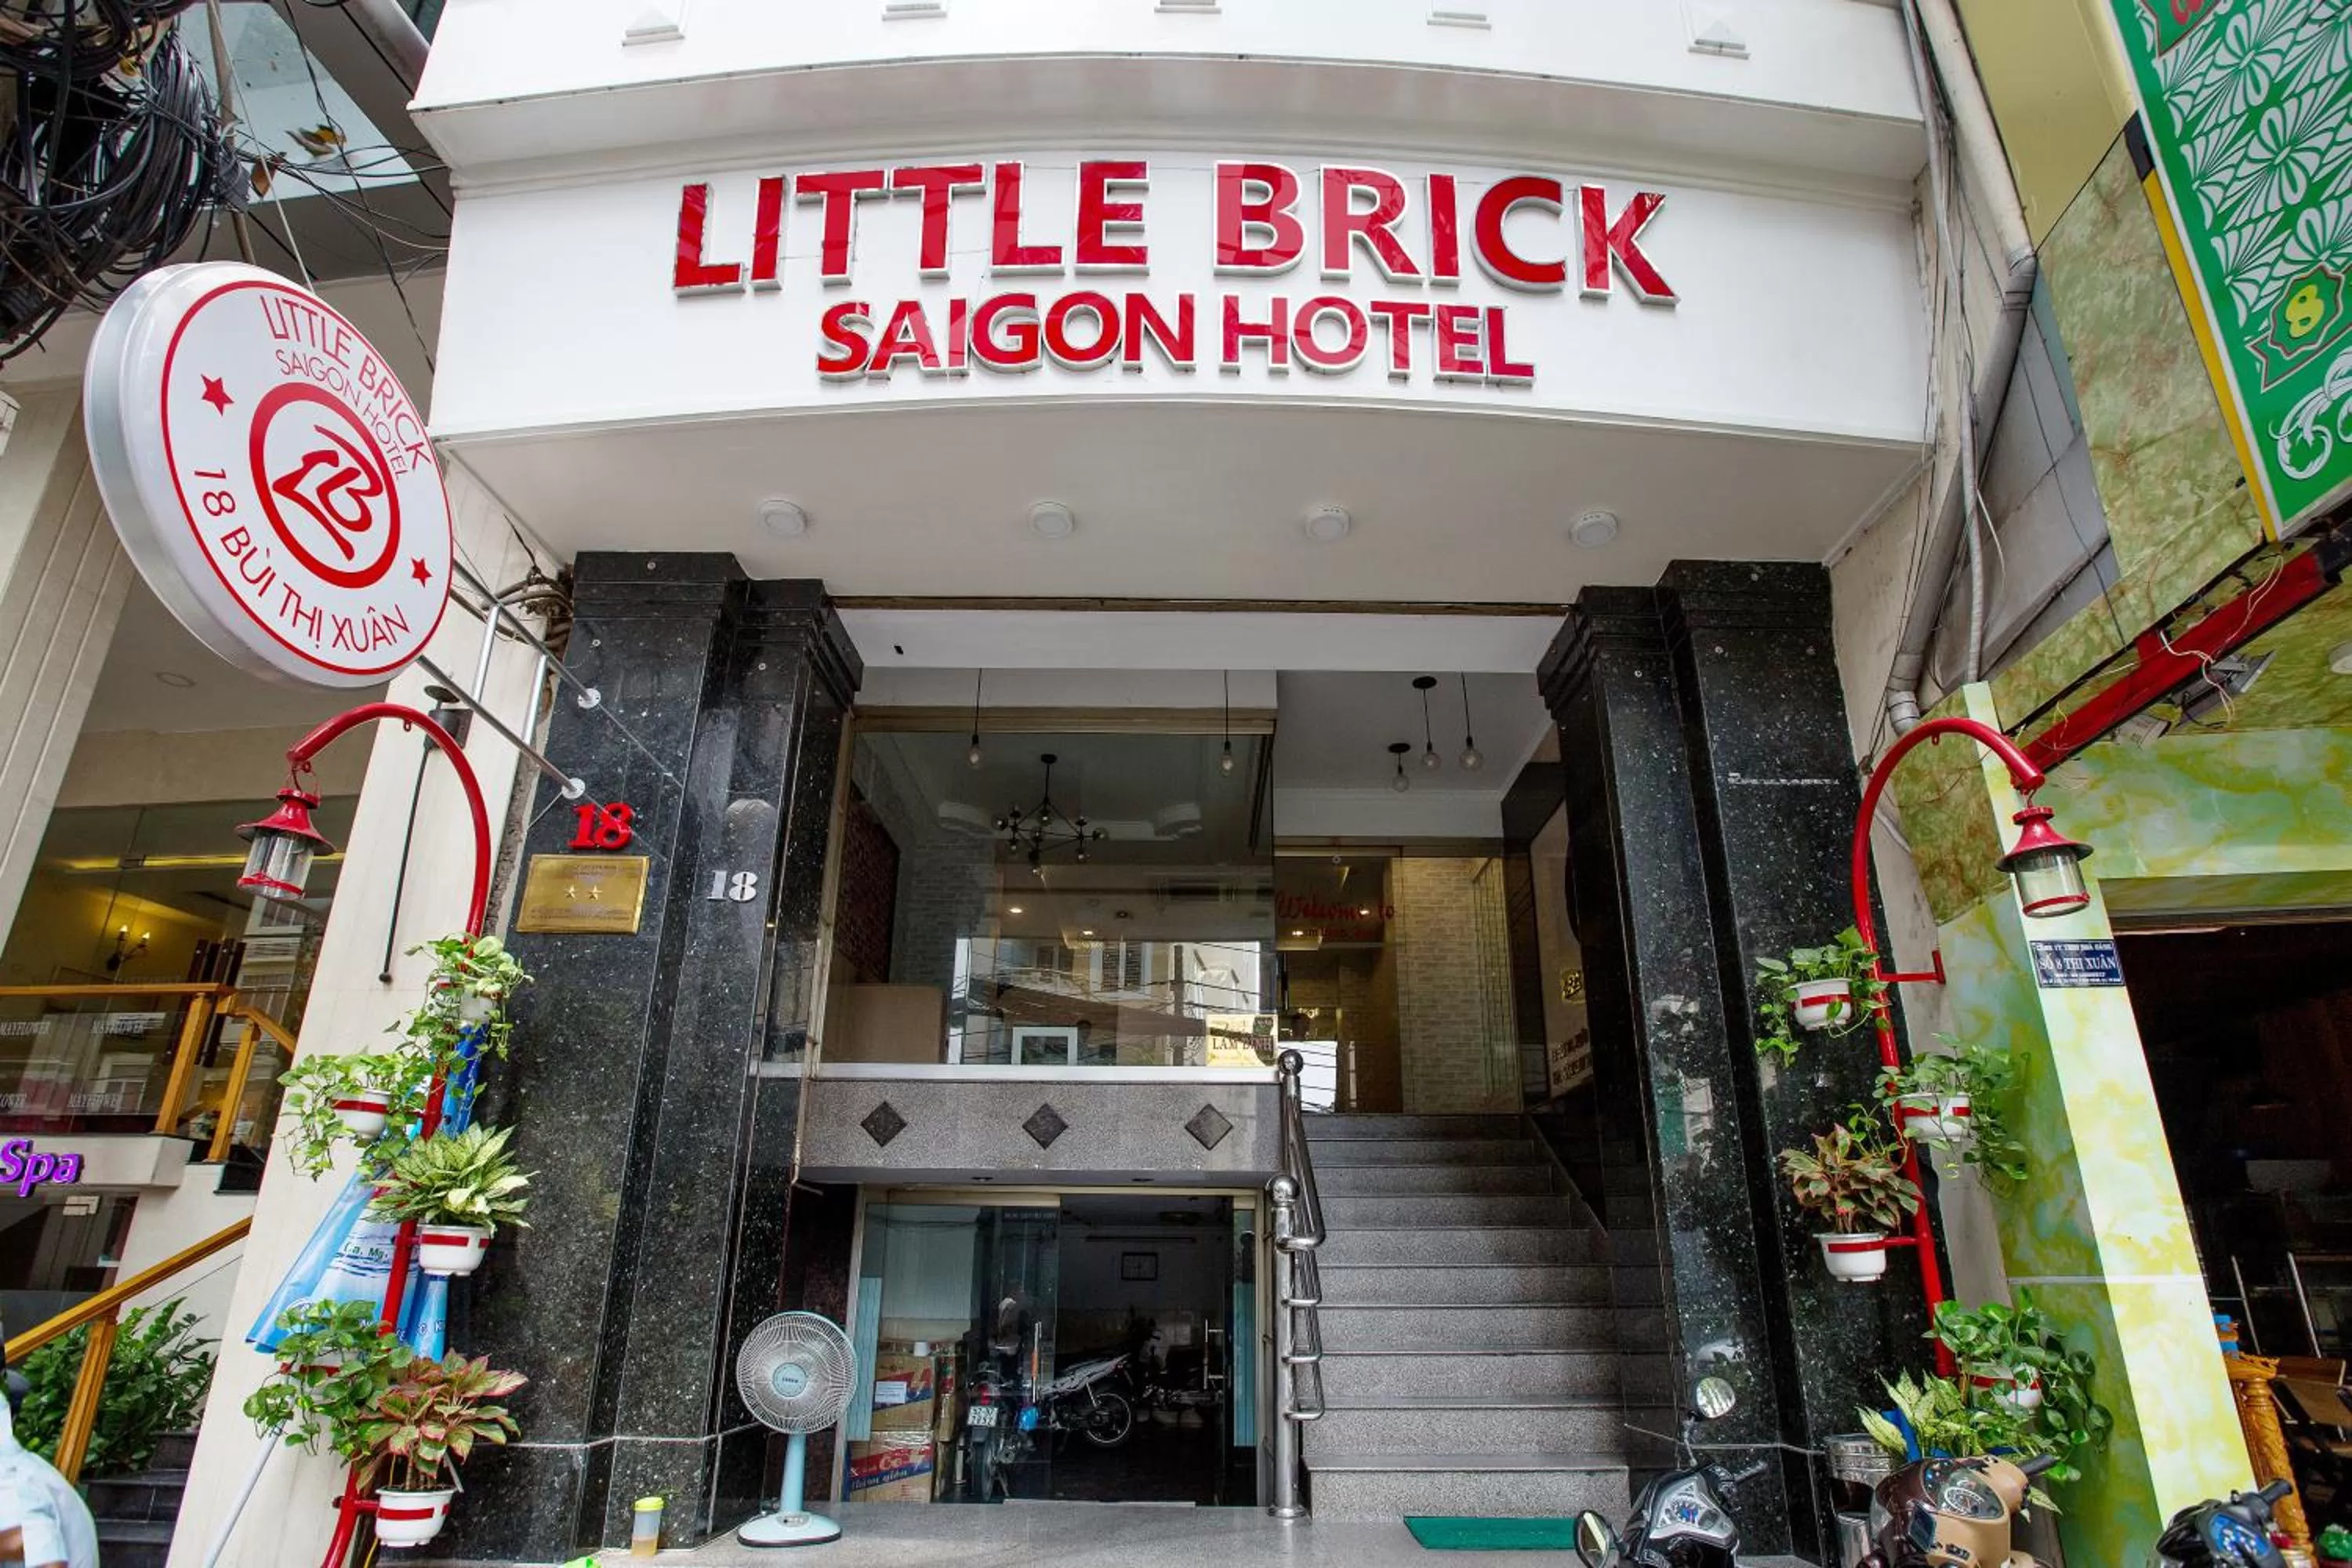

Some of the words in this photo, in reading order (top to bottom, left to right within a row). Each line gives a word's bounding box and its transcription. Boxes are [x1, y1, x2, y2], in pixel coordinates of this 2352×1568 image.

[673, 161, 1149, 296] LITTLE
[1213, 161, 1679, 309] BRICK
[260, 295, 352, 370] LITTLE
[358, 354, 431, 470] BRICK
[815, 290, 1196, 383] SAIGON
[1219, 293, 1534, 388] HOTEL
[275, 349, 361, 408] SAIGON
[363, 403, 408, 481] HOTEL
[194, 468, 236, 517] 18
[220, 525, 277, 597] BÙI
[279, 582, 323, 649] THỊ
[332, 603, 410, 653] XUÂN
[568, 802, 633, 851] 18
[706, 869, 759, 902] 18
[2085, 953, 2117, 970] XUÂN
[0, 1138, 80, 1197] Spa
